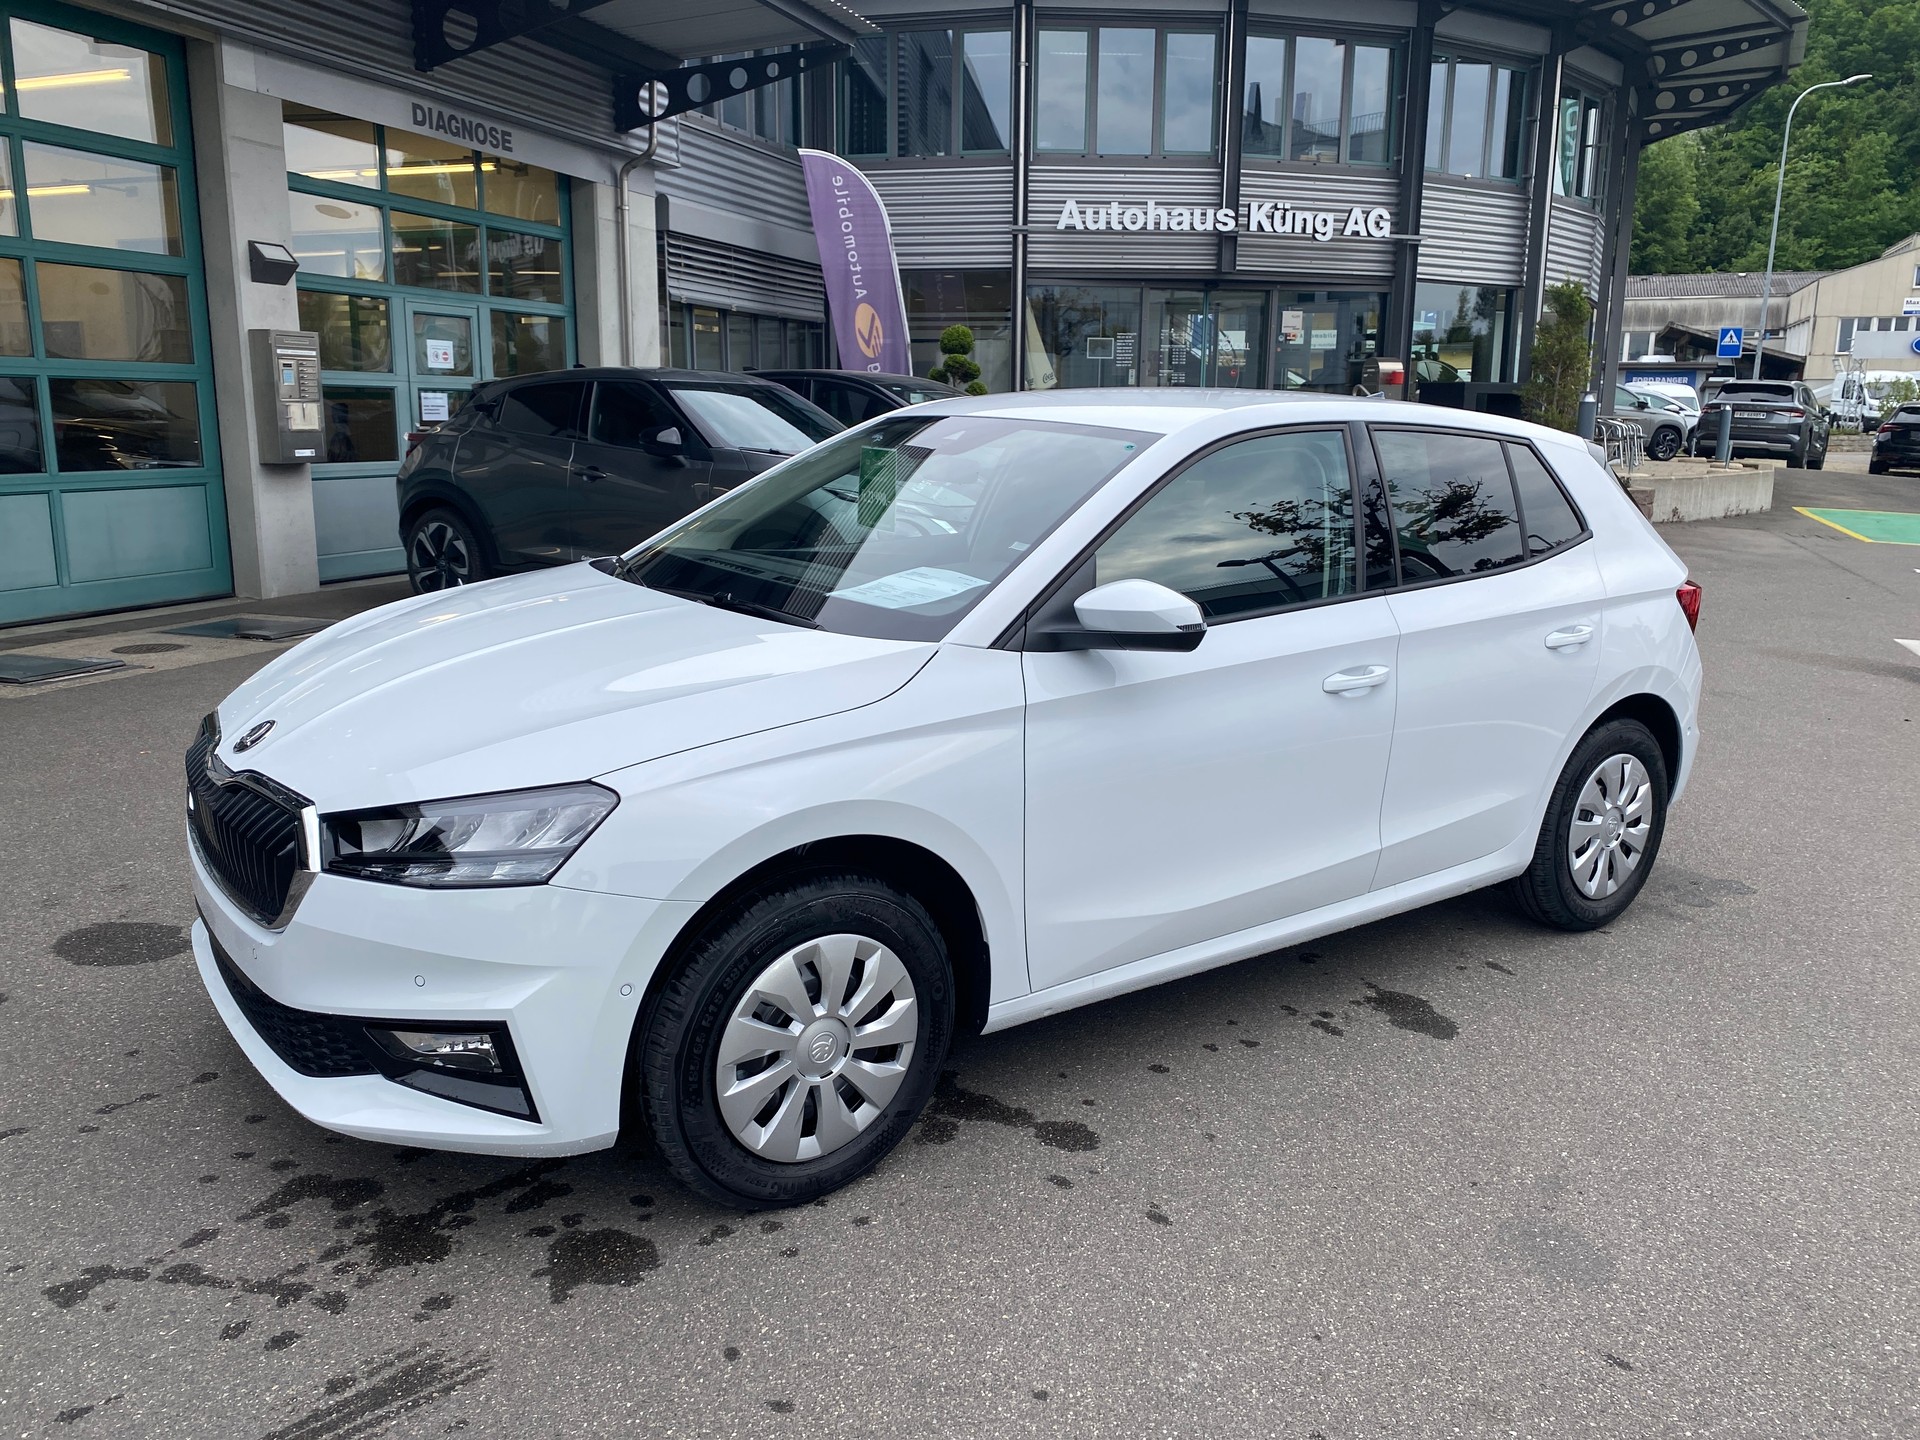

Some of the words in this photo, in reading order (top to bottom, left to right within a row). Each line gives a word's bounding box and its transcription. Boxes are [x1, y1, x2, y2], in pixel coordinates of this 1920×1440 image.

[411, 102, 513, 153] DIAGNOSE
[1056, 200, 1236, 232] Autohaus
[1249, 202, 1335, 242] Küng
[1343, 207, 1391, 238] AG
[1655, 376, 1688, 384] RANGER
